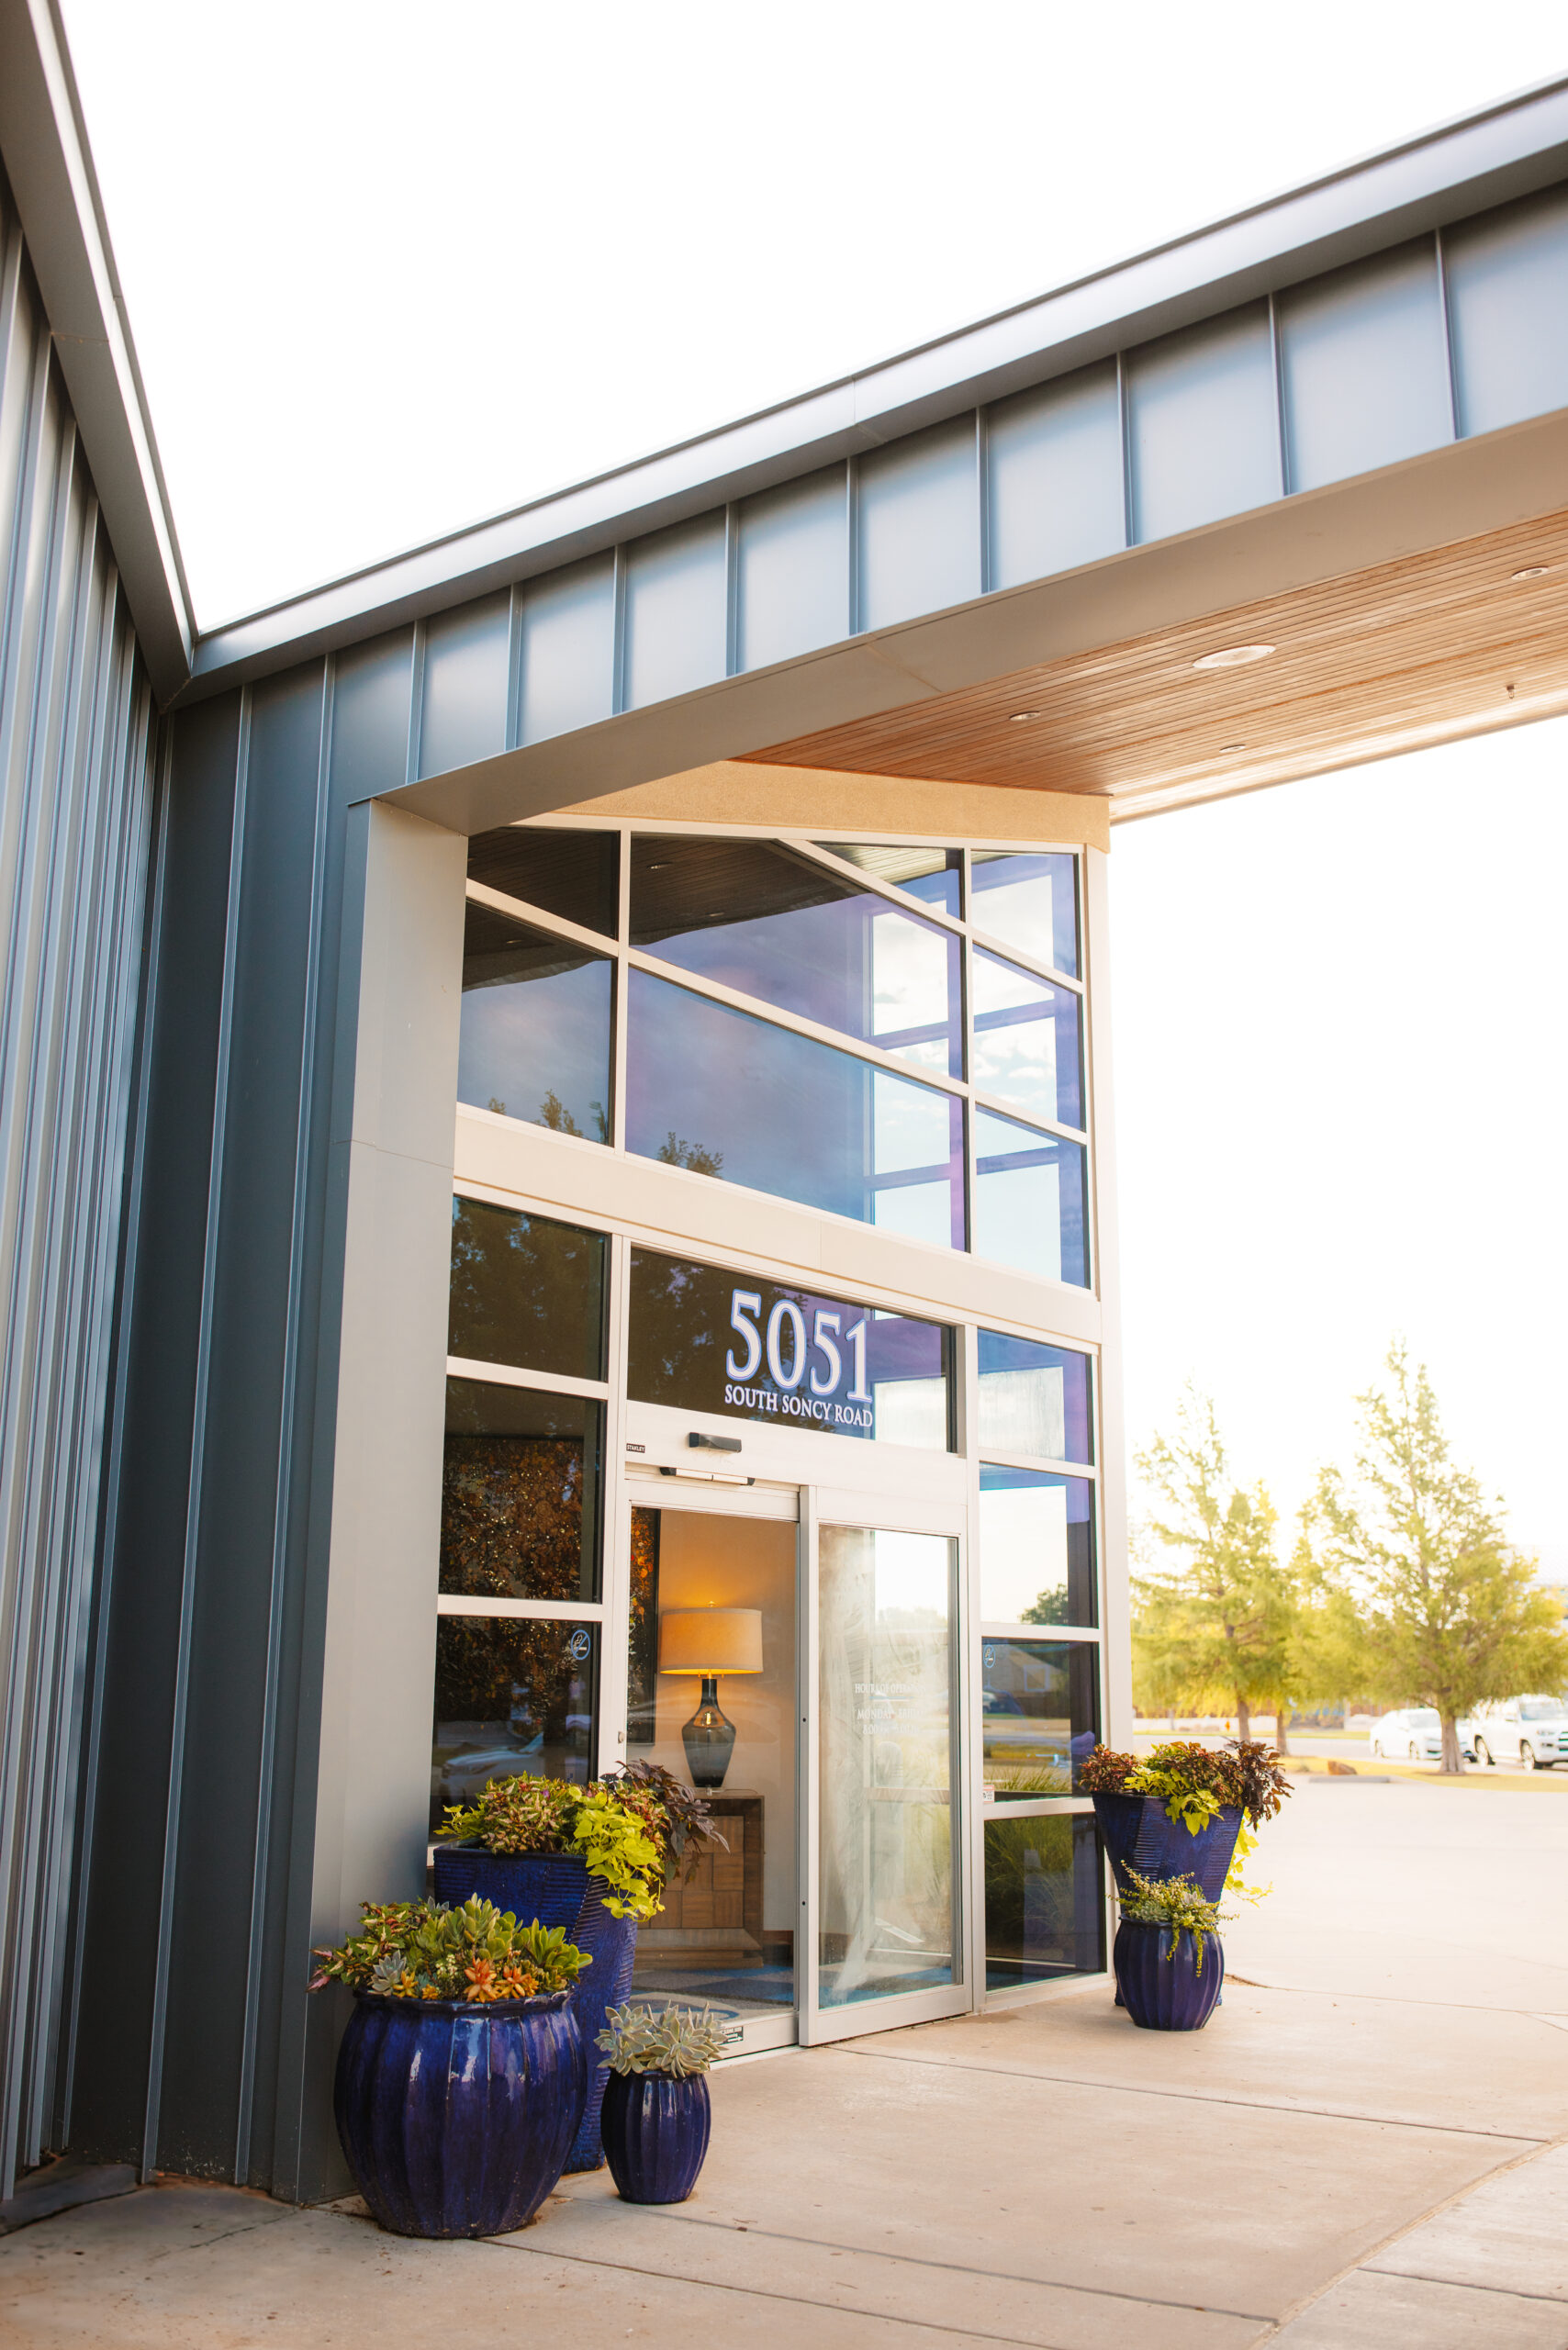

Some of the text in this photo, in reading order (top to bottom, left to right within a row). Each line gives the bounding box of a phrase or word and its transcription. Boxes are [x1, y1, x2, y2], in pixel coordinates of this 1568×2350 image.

[726, 1288, 873, 1403] 5051
[724, 1384, 873, 1427] SOUTH SONCY ROAD
